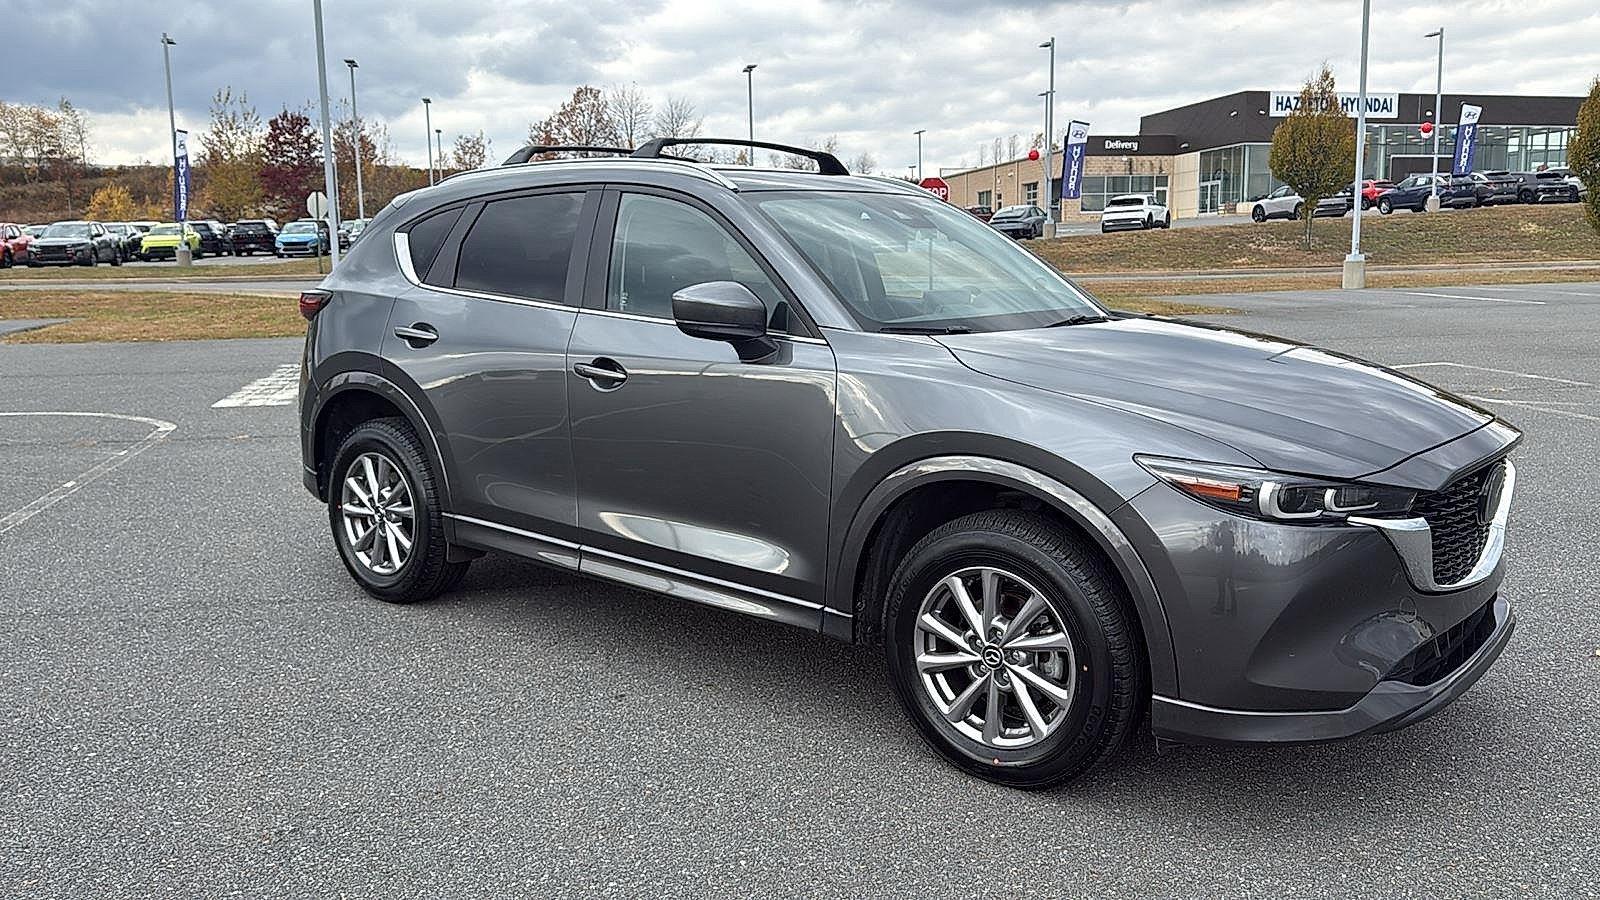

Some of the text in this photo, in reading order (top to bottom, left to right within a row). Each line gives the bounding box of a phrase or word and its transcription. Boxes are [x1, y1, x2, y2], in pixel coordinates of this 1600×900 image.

[1275, 96, 1337, 111] HAZTO
[1105, 140, 1138, 151] Delivery
[1460, 126, 1473, 173] HYUNDAI
[179, 158, 187, 219] HYUNDAI
[1069, 146, 1081, 197] HYUNDAI
